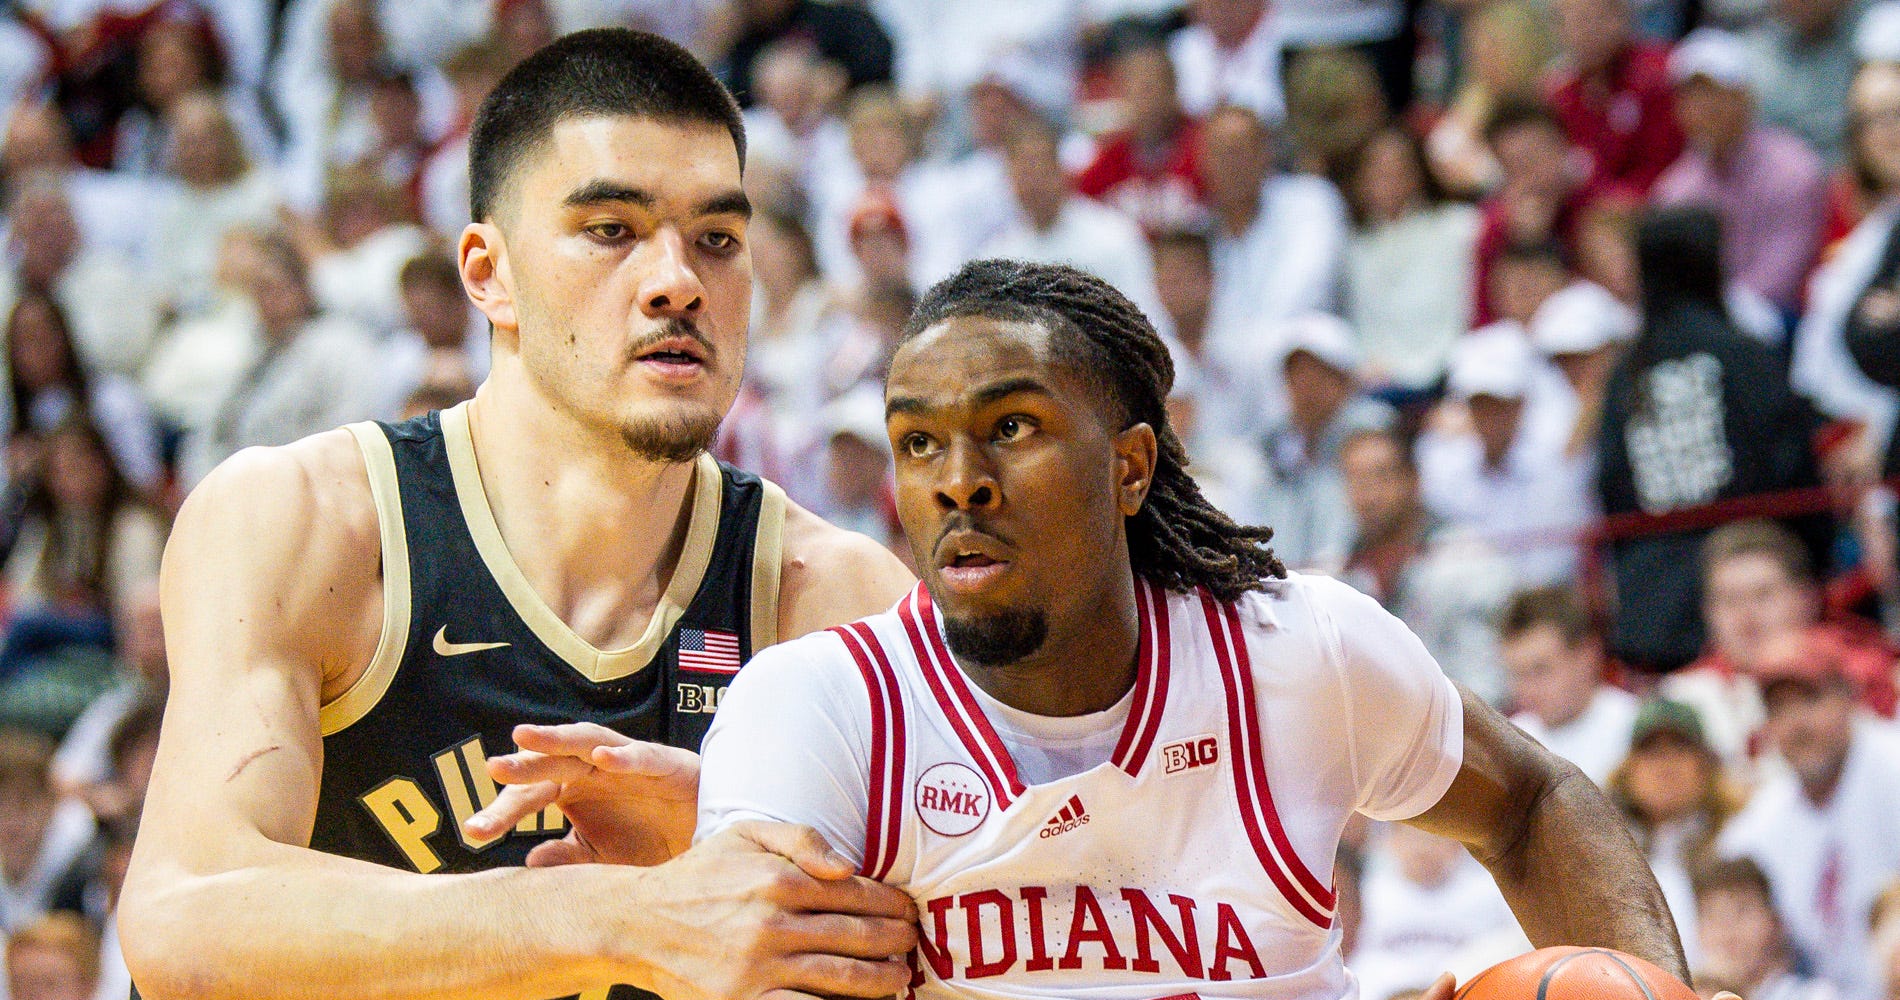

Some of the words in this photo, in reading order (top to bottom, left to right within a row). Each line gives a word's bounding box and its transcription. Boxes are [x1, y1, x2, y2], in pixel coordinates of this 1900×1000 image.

[359, 733, 567, 874] PU
[920, 785, 982, 817] RMK
[1039, 813, 1091, 839] adidas
